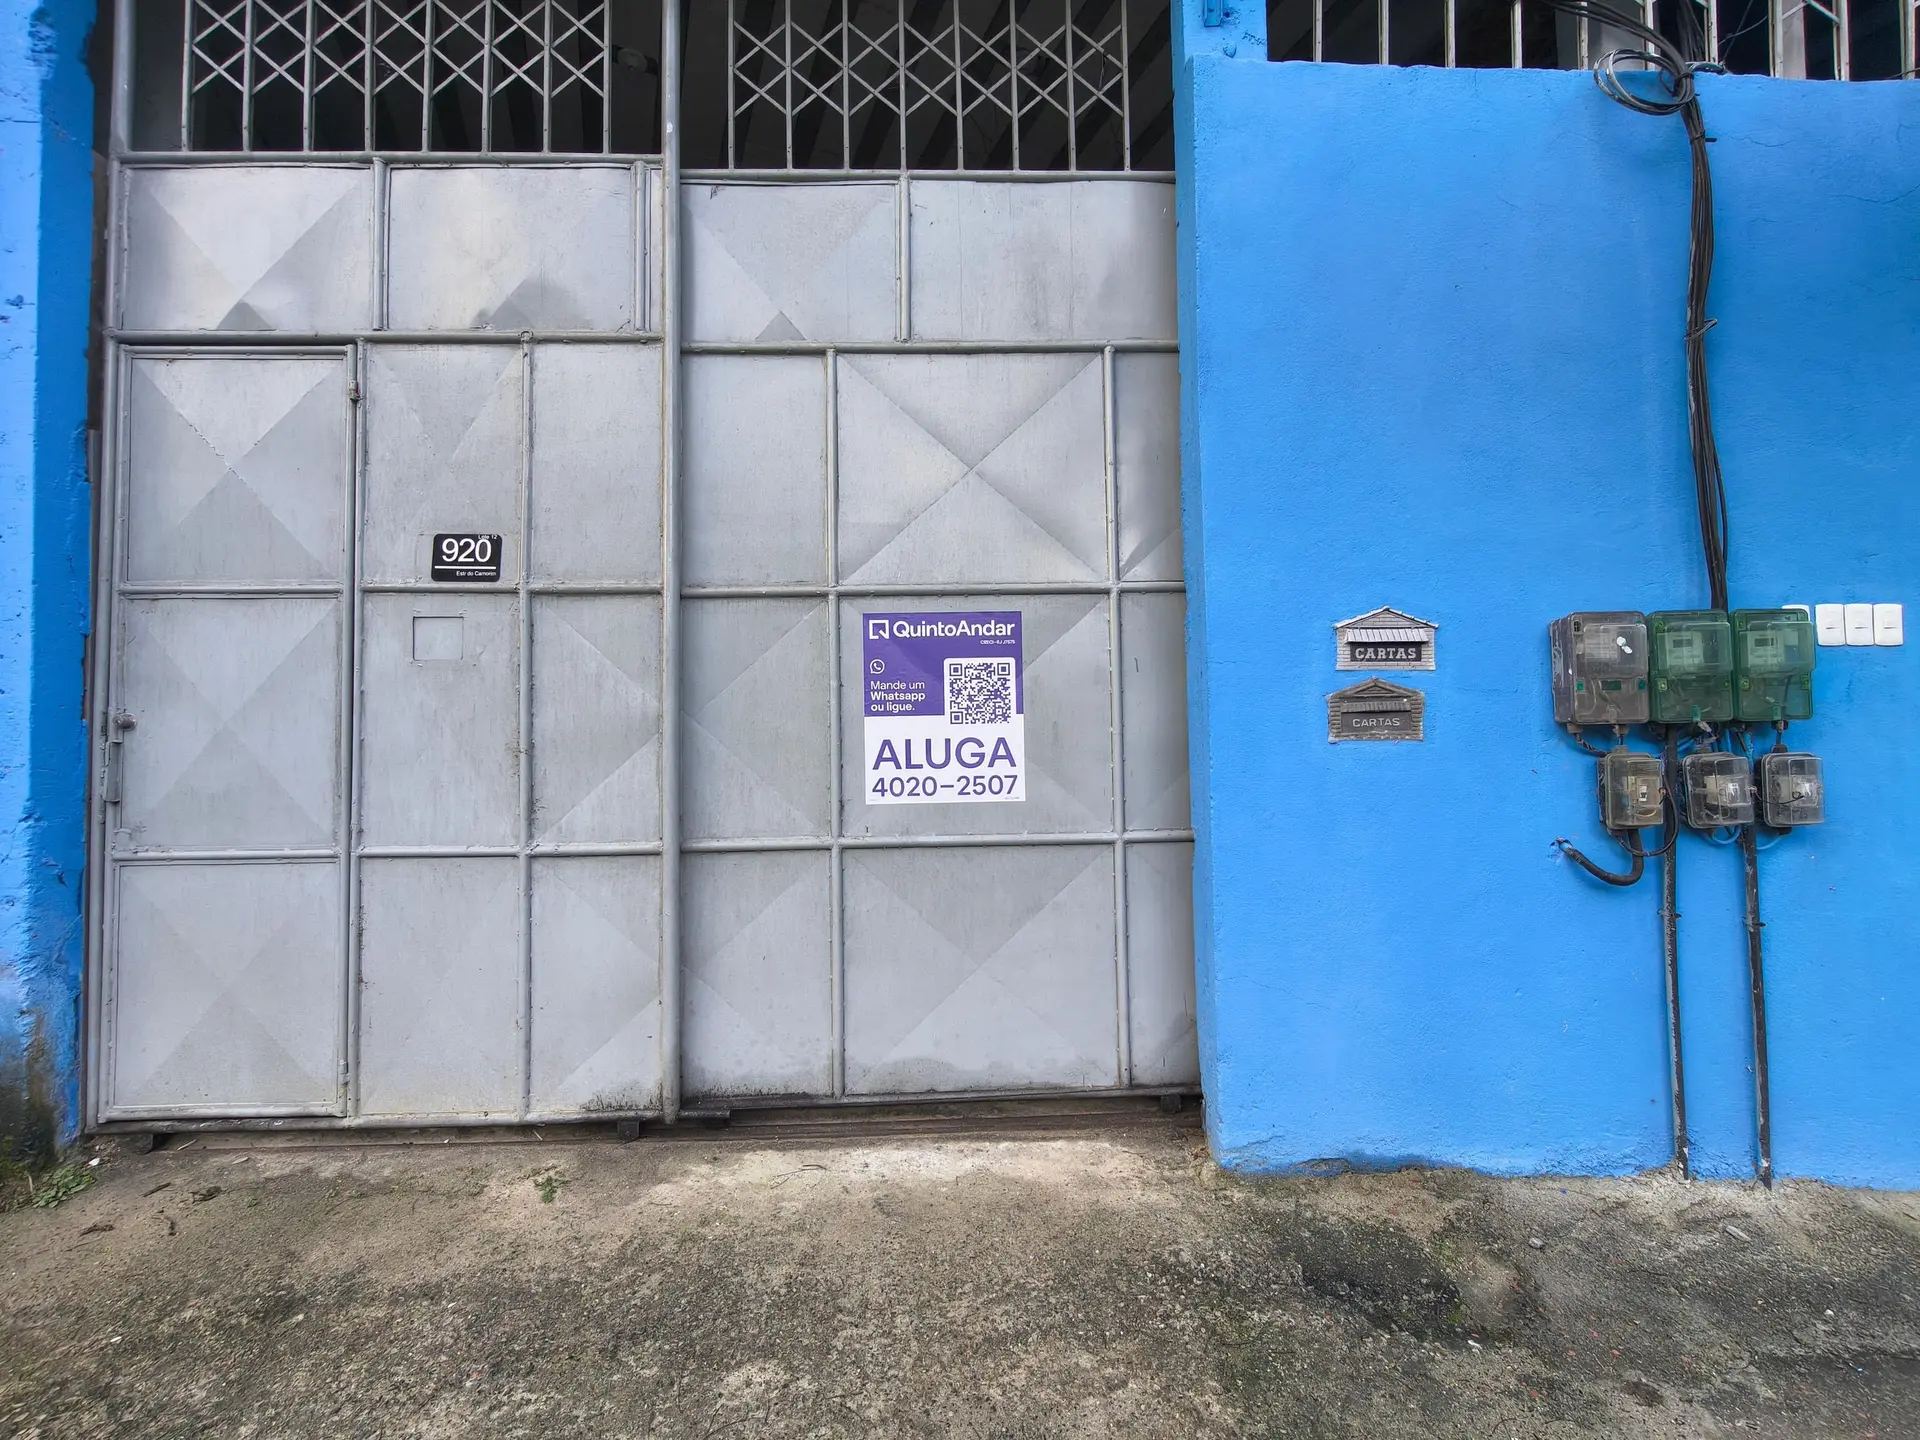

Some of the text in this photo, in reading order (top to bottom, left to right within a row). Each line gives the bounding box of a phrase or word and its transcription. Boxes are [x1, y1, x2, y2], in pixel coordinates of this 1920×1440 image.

[442, 538, 492, 562] 920
[893, 620, 1015, 638] QuintoAndar
[1355, 647, 1417, 659] CARTAS
[870, 681, 925, 690] Mande um
[870, 691, 926, 702] Whatsapp
[870, 702, 915, 713] ou ligue.
[1352, 717, 1401, 727] CARTAS
[872, 737, 1017, 770] ALUGA
[872, 775, 1018, 797] 4020-2507
